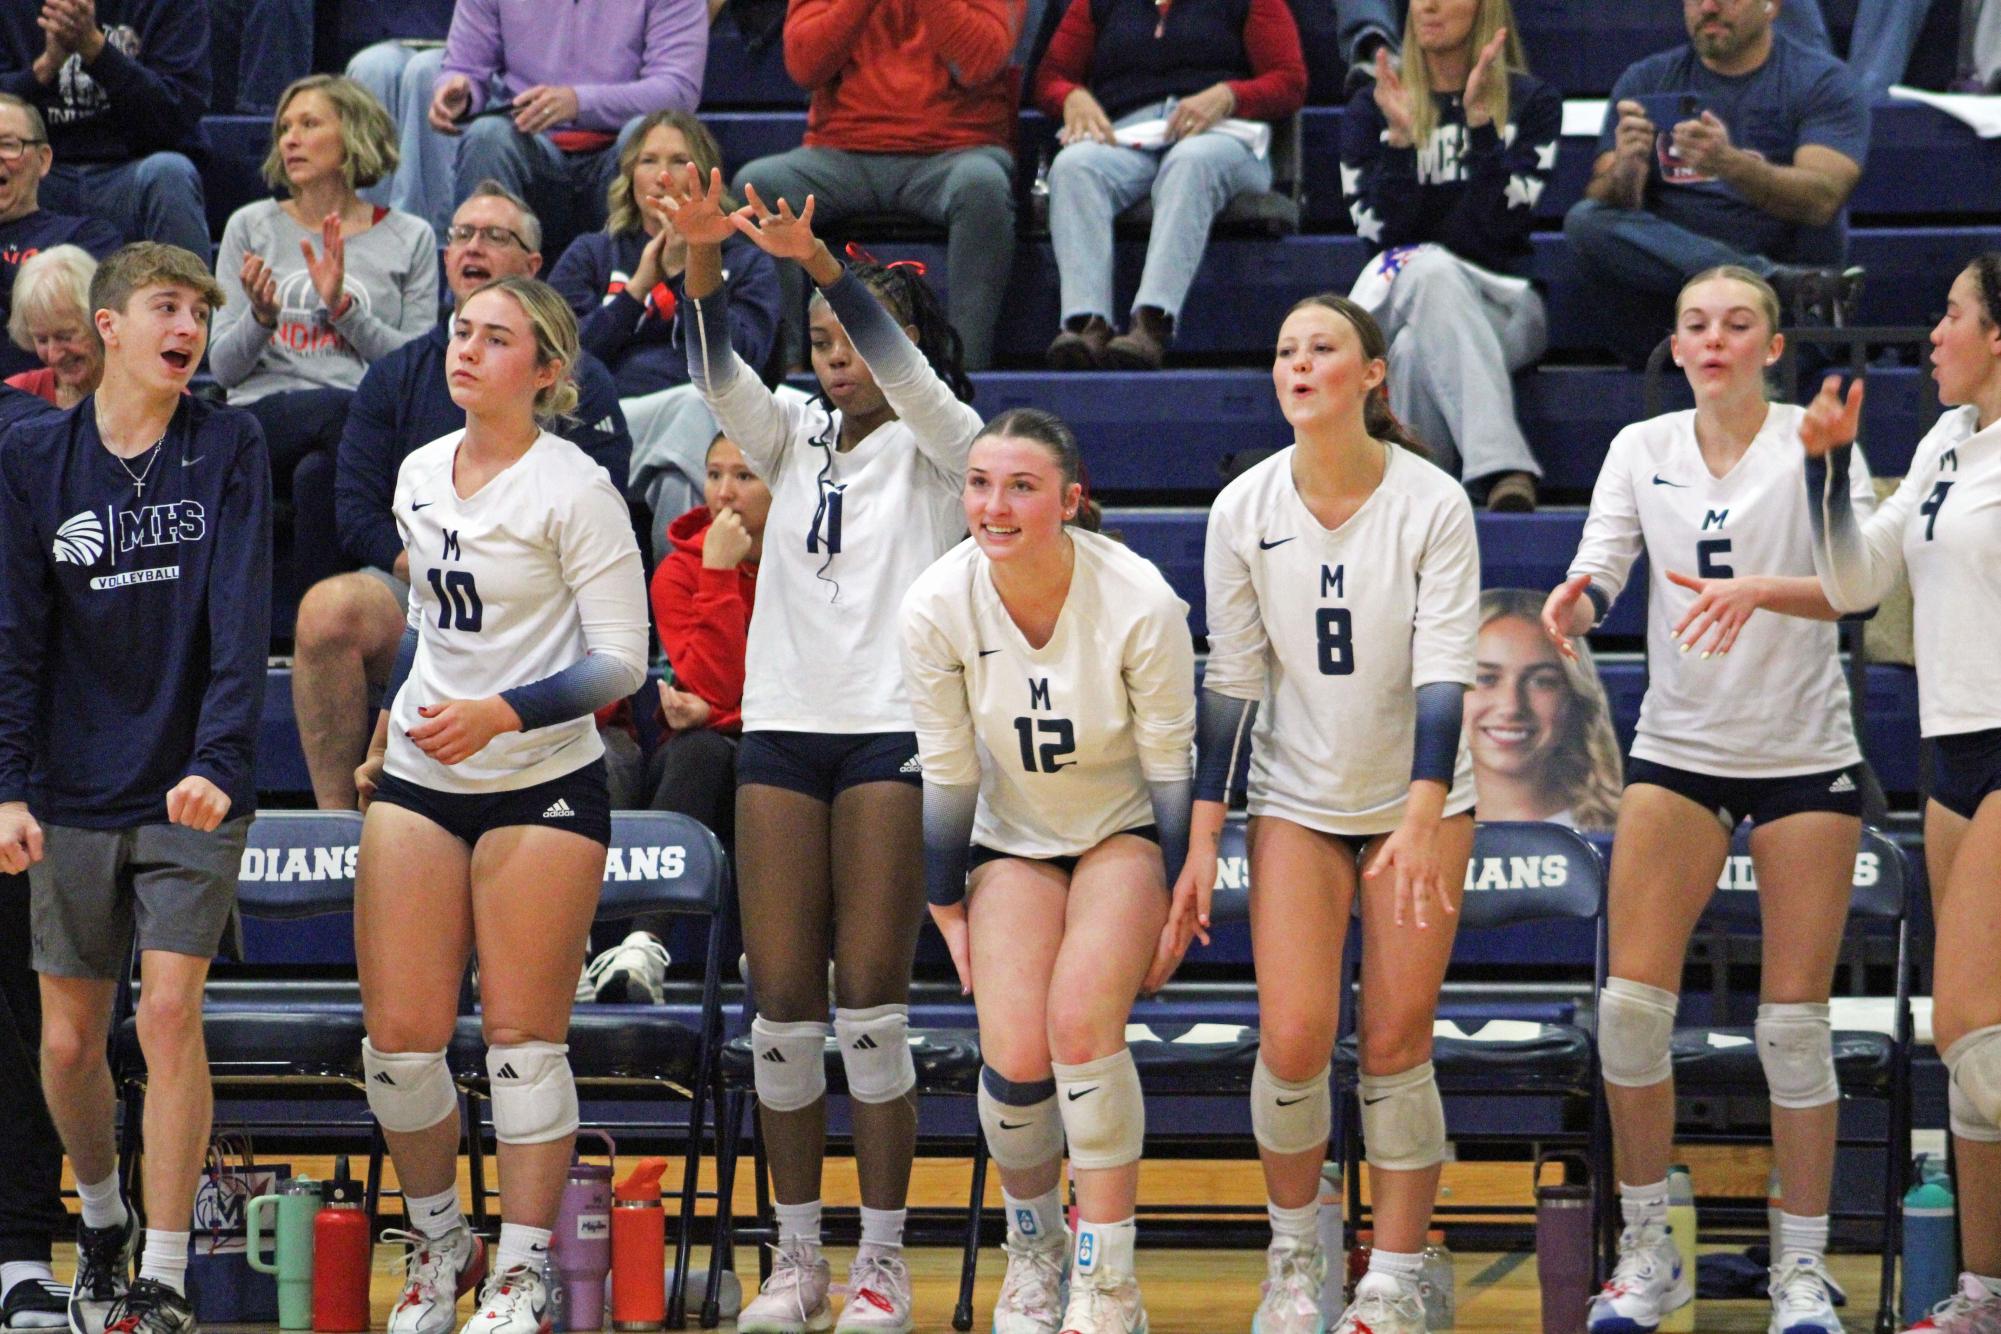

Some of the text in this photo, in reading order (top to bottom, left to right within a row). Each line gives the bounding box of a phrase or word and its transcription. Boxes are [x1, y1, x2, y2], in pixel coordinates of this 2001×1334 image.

[119, 499, 206, 552] MHS
[1702, 509, 1729, 530] M
[442, 528, 460, 561] M
[98, 567, 179, 589] VOLLEYBALL
[1320, 564, 1344, 598] M
[427, 568, 483, 633] 10
[1315, 607, 1355, 675] 8
[1028, 677, 1051, 711] M
[1014, 716, 1077, 774] 12
[542, 808, 575, 818] adidas
